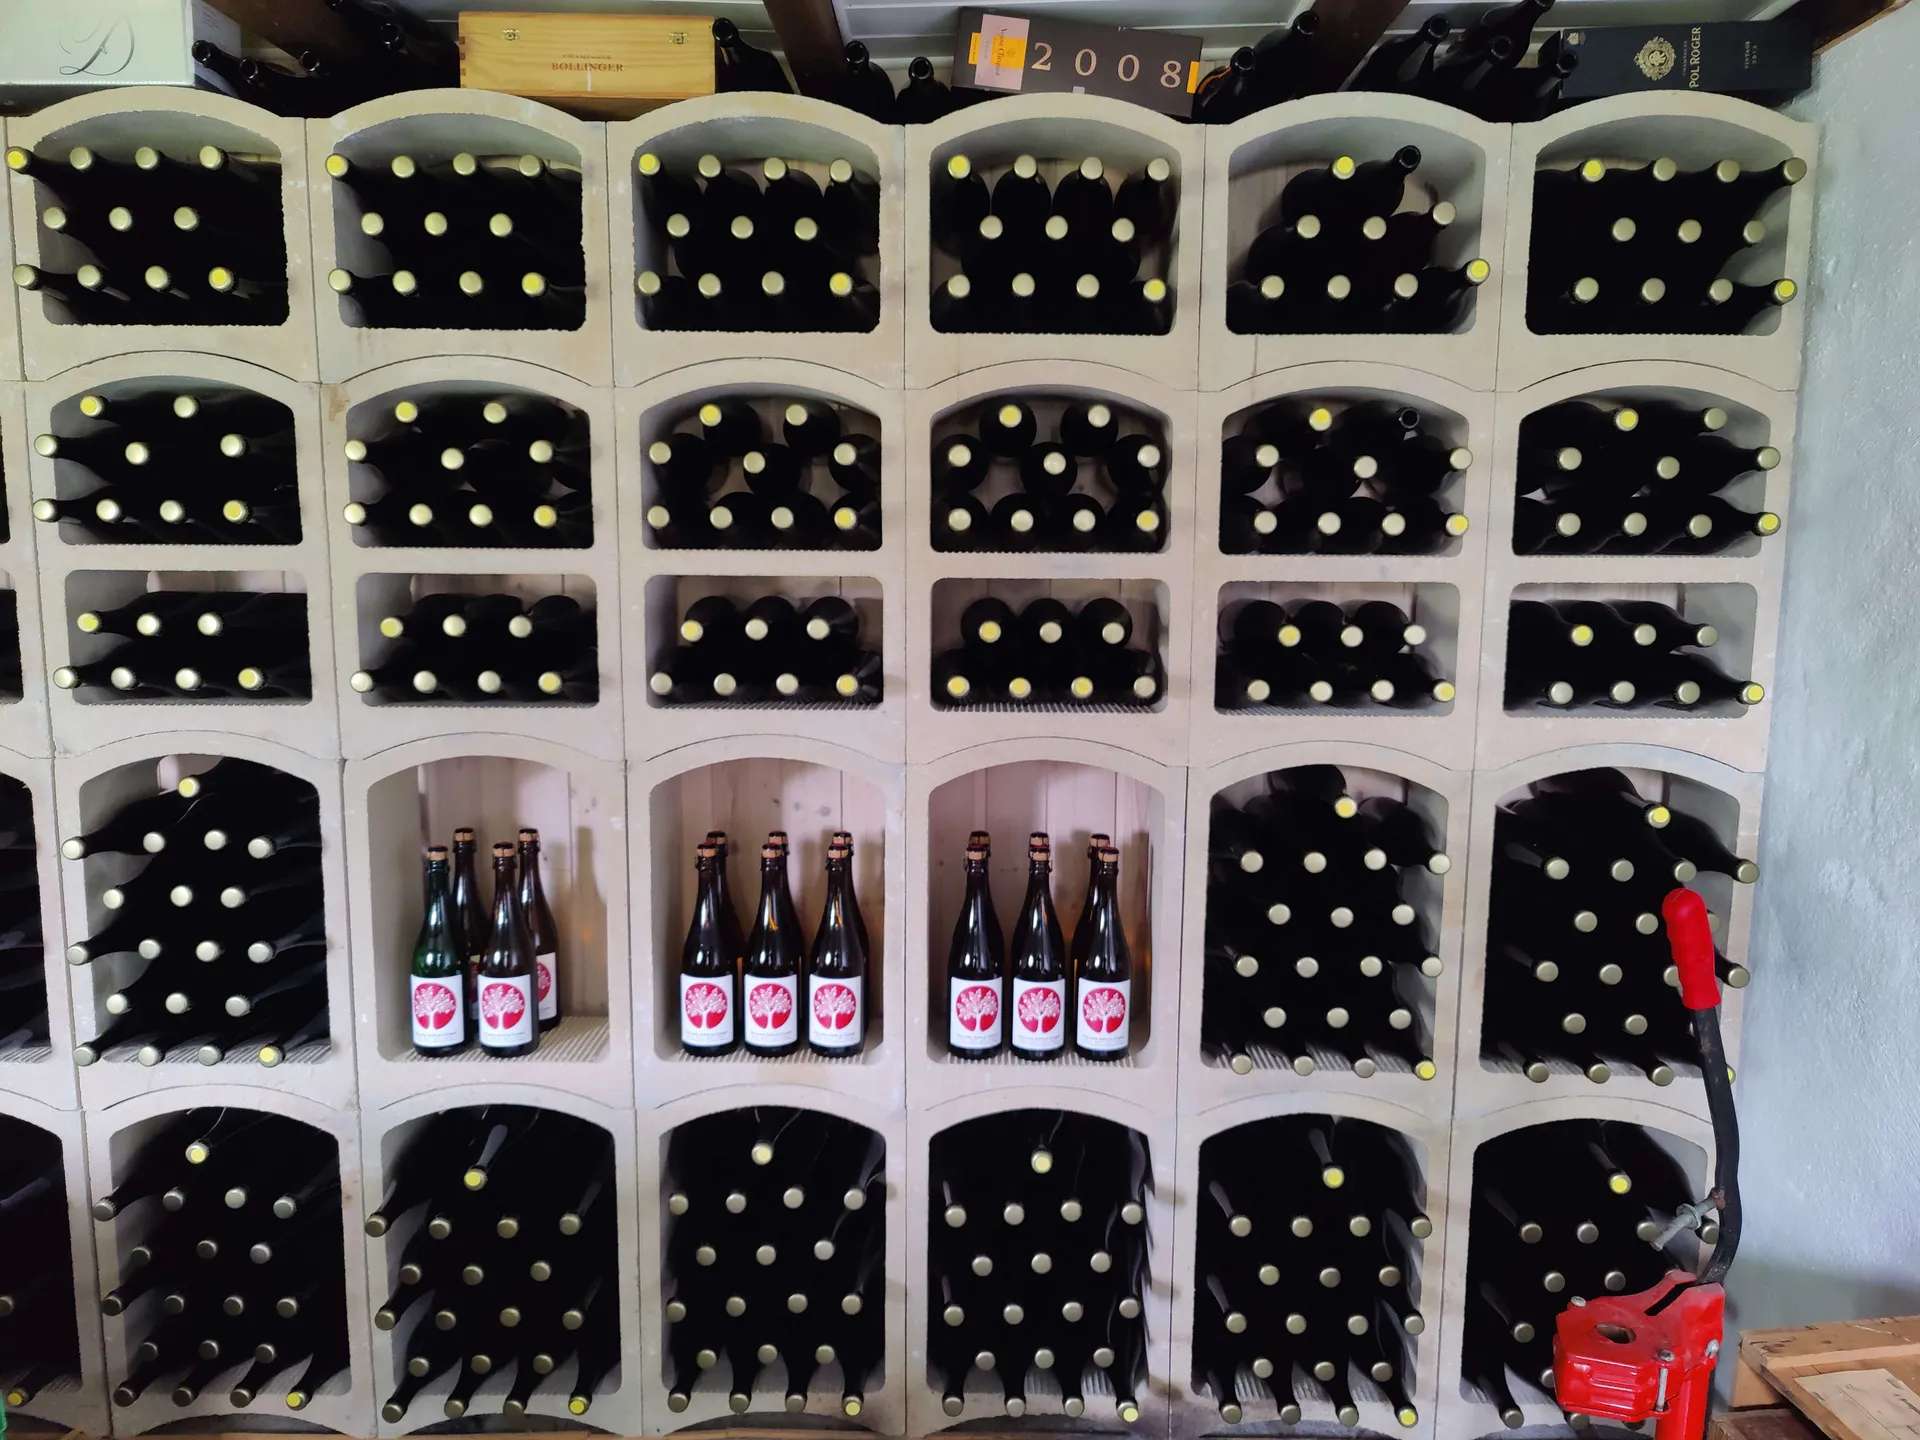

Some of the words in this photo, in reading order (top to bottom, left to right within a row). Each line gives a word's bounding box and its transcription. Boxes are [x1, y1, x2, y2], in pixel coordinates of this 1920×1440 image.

[1689, 26, 1701, 66] ROGER
[552, 62, 624, 72] BOLLINGER
[1688, 66, 1700, 89] POL
